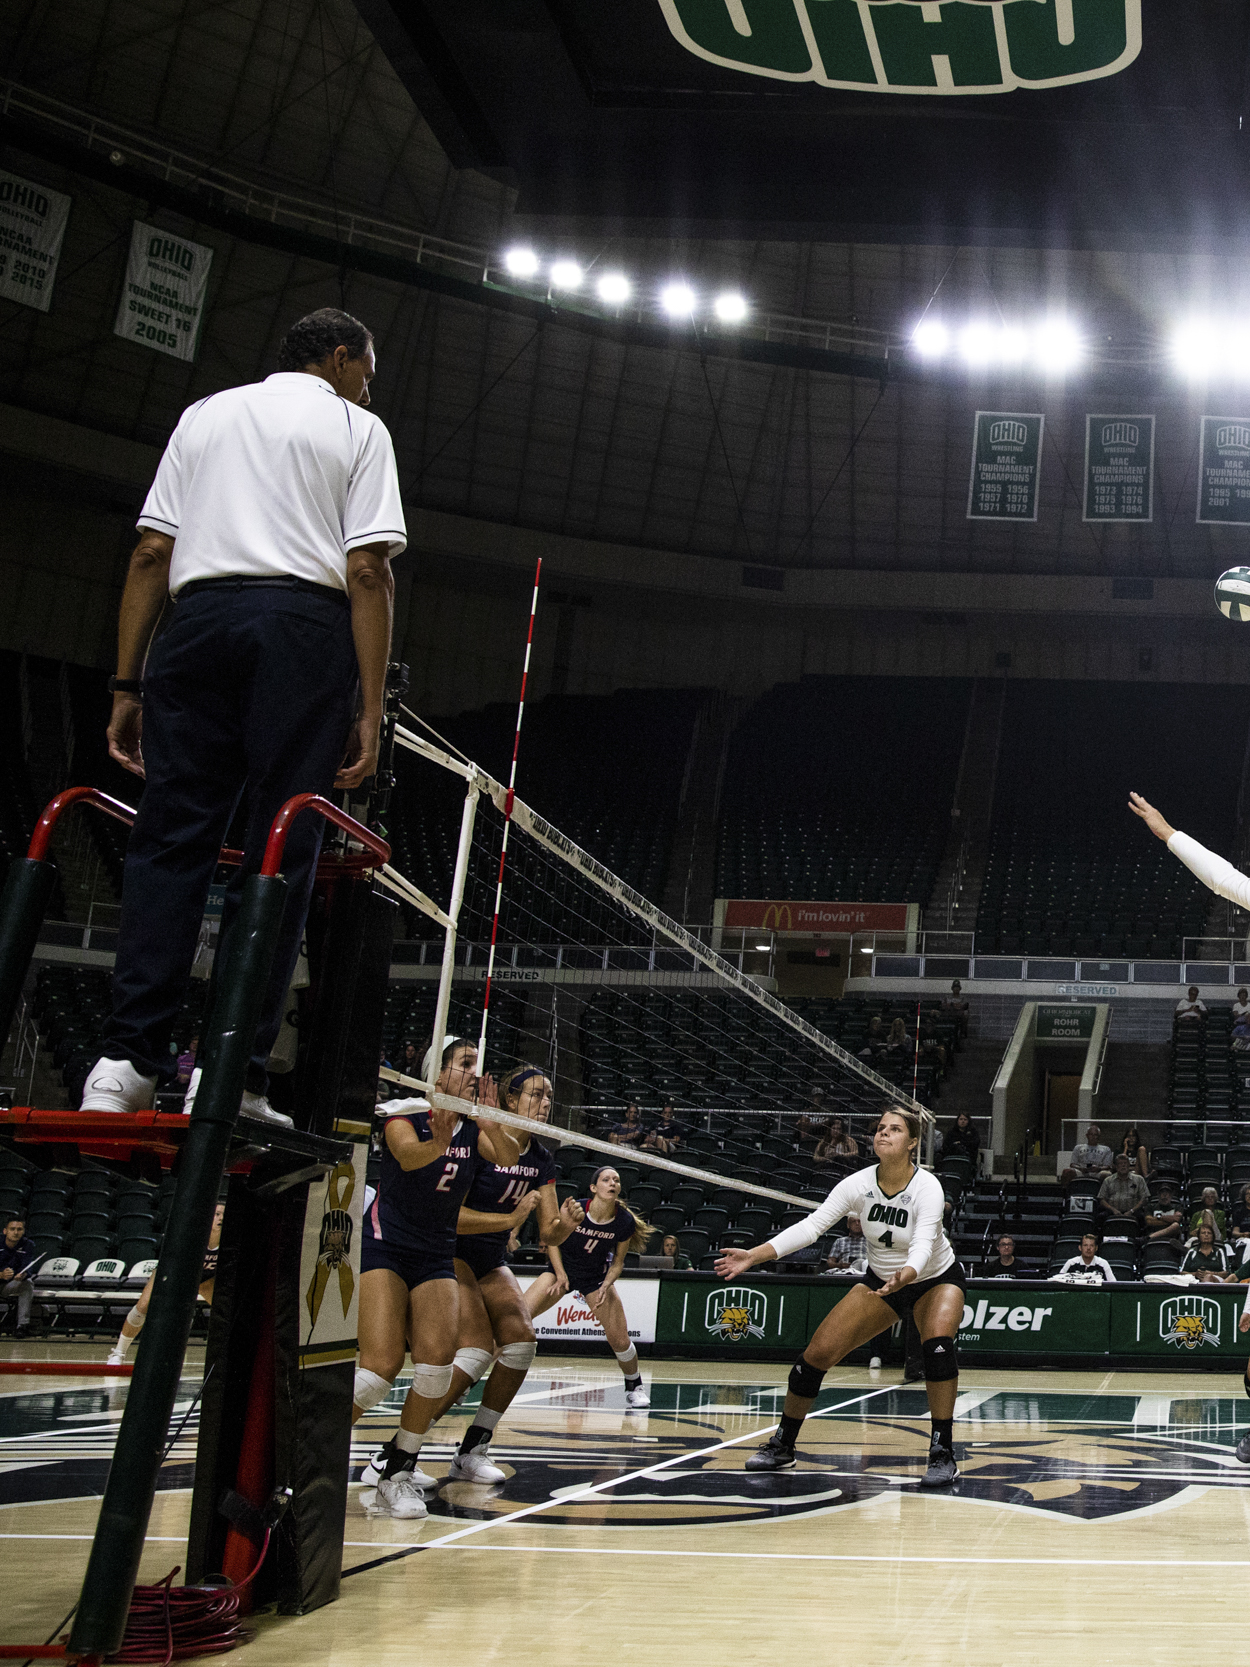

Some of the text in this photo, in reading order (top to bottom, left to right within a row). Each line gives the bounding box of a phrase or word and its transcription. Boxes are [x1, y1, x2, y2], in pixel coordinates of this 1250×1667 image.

[0, 181, 48, 217] OHIO
[0, 226, 32, 246] NCAA
[148, 238, 194, 272] OHIO
[148, 261, 188, 281] VOLLEYBALL
[11, 271, 43, 290] 2015
[150, 282, 178, 300] NCAA
[128, 283, 199, 317] TOURNAMENT
[129, 300, 191, 333] SWEET 16
[134, 322, 178, 349] 2005
[990, 421, 1027, 445] OHIO
[1102, 423, 1139, 446] OHIO
[997, 456, 1016, 464] MAC
[1110, 458, 1129, 466] MAC
[1224, 460, 1244, 469] MAC
[978, 463, 1034, 474] TOURNAMENT
[1092, 466, 1147, 475] TOURNAMENT
[980, 472, 1030, 482] CHAMPIONS
[1094, 475, 1143, 483] CHAMPIONS
[1007, 484, 1029, 494] 1956
[979, 502, 1027, 513] 1971 1972
[798, 910, 817, 922] i'm
[818, 910, 854, 922] lovin'
[855, 911, 865, 922] it
[482, 970, 539, 980] RESERVED
[1057, 985, 1117, 995] RESERVED
[1054, 1018, 1080, 1026] ROHR
[1052, 1028, 1080, 1036] ROOM
[435, 1162, 459, 1192] 2
[494, 1164, 539, 1177] SAMFORD
[497, 1179, 529, 1205] 14
[868, 1204, 908, 1228] OHIO
[575, 1226, 615, 1239] SAMFORD
[878, 1230, 895, 1248] 4
[584, 1239, 600, 1253] 4
[95, 1261, 117, 1273] OHIO
[705, 1287, 767, 1329] OHIO
[958, 1300, 1052, 1332] olzer
[1159, 1296, 1221, 1338] OHIO
[541, 1327, 580, 1336] Convenient
[582, 1328, 606, 1336] Athens
[955, 1332, 980, 1343] stem
